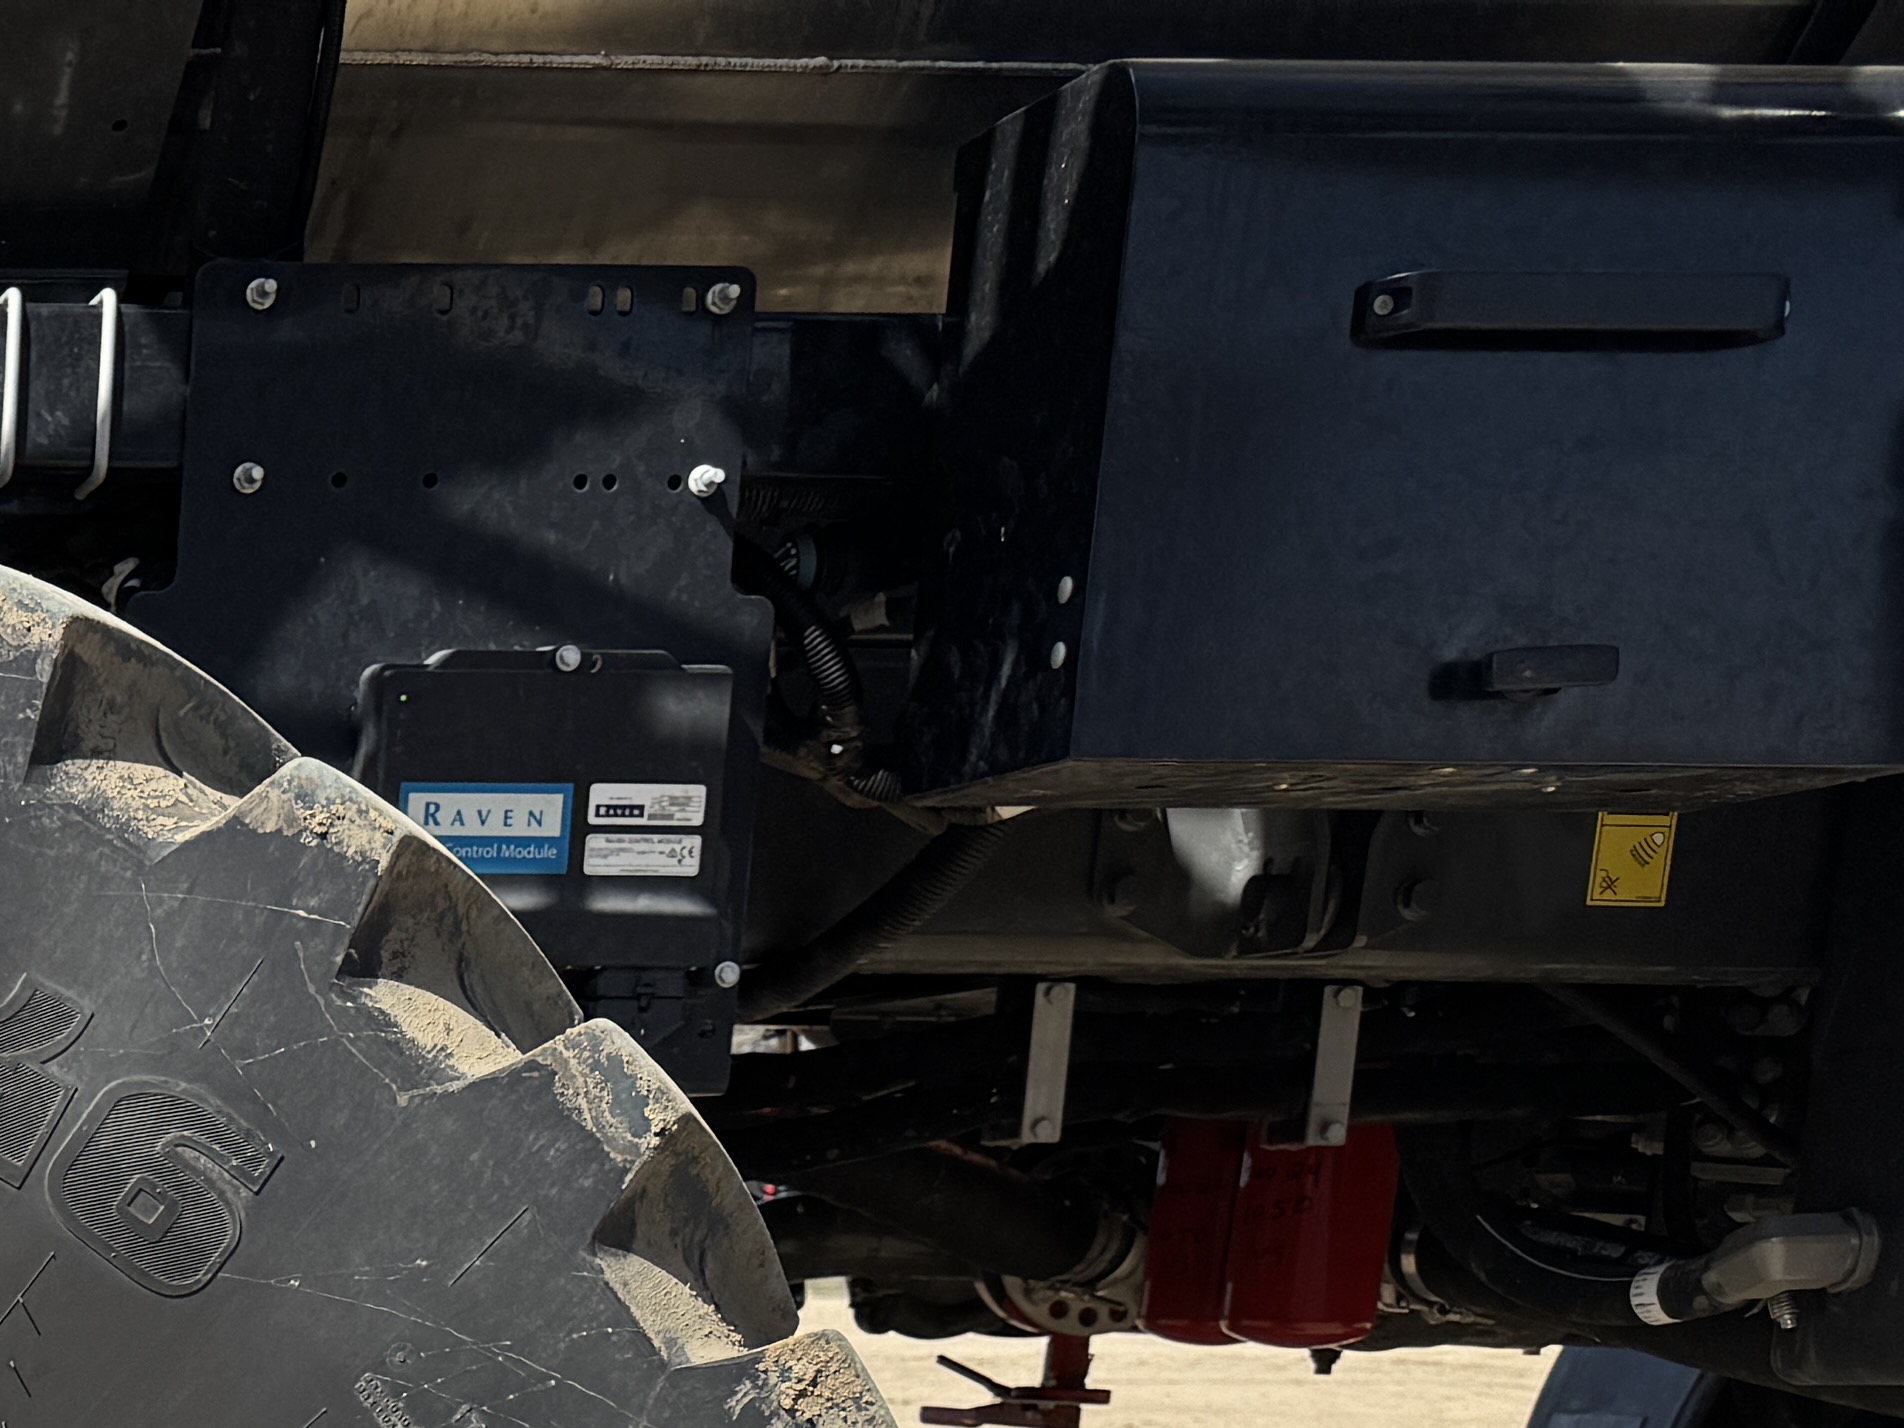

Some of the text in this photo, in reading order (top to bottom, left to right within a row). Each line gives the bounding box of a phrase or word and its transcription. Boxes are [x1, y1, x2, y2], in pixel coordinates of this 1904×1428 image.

[423, 801, 544, 829] RAVEN
[598, 806, 643, 818] RAVEN
[446, 842, 558, 860] ontrol Module
